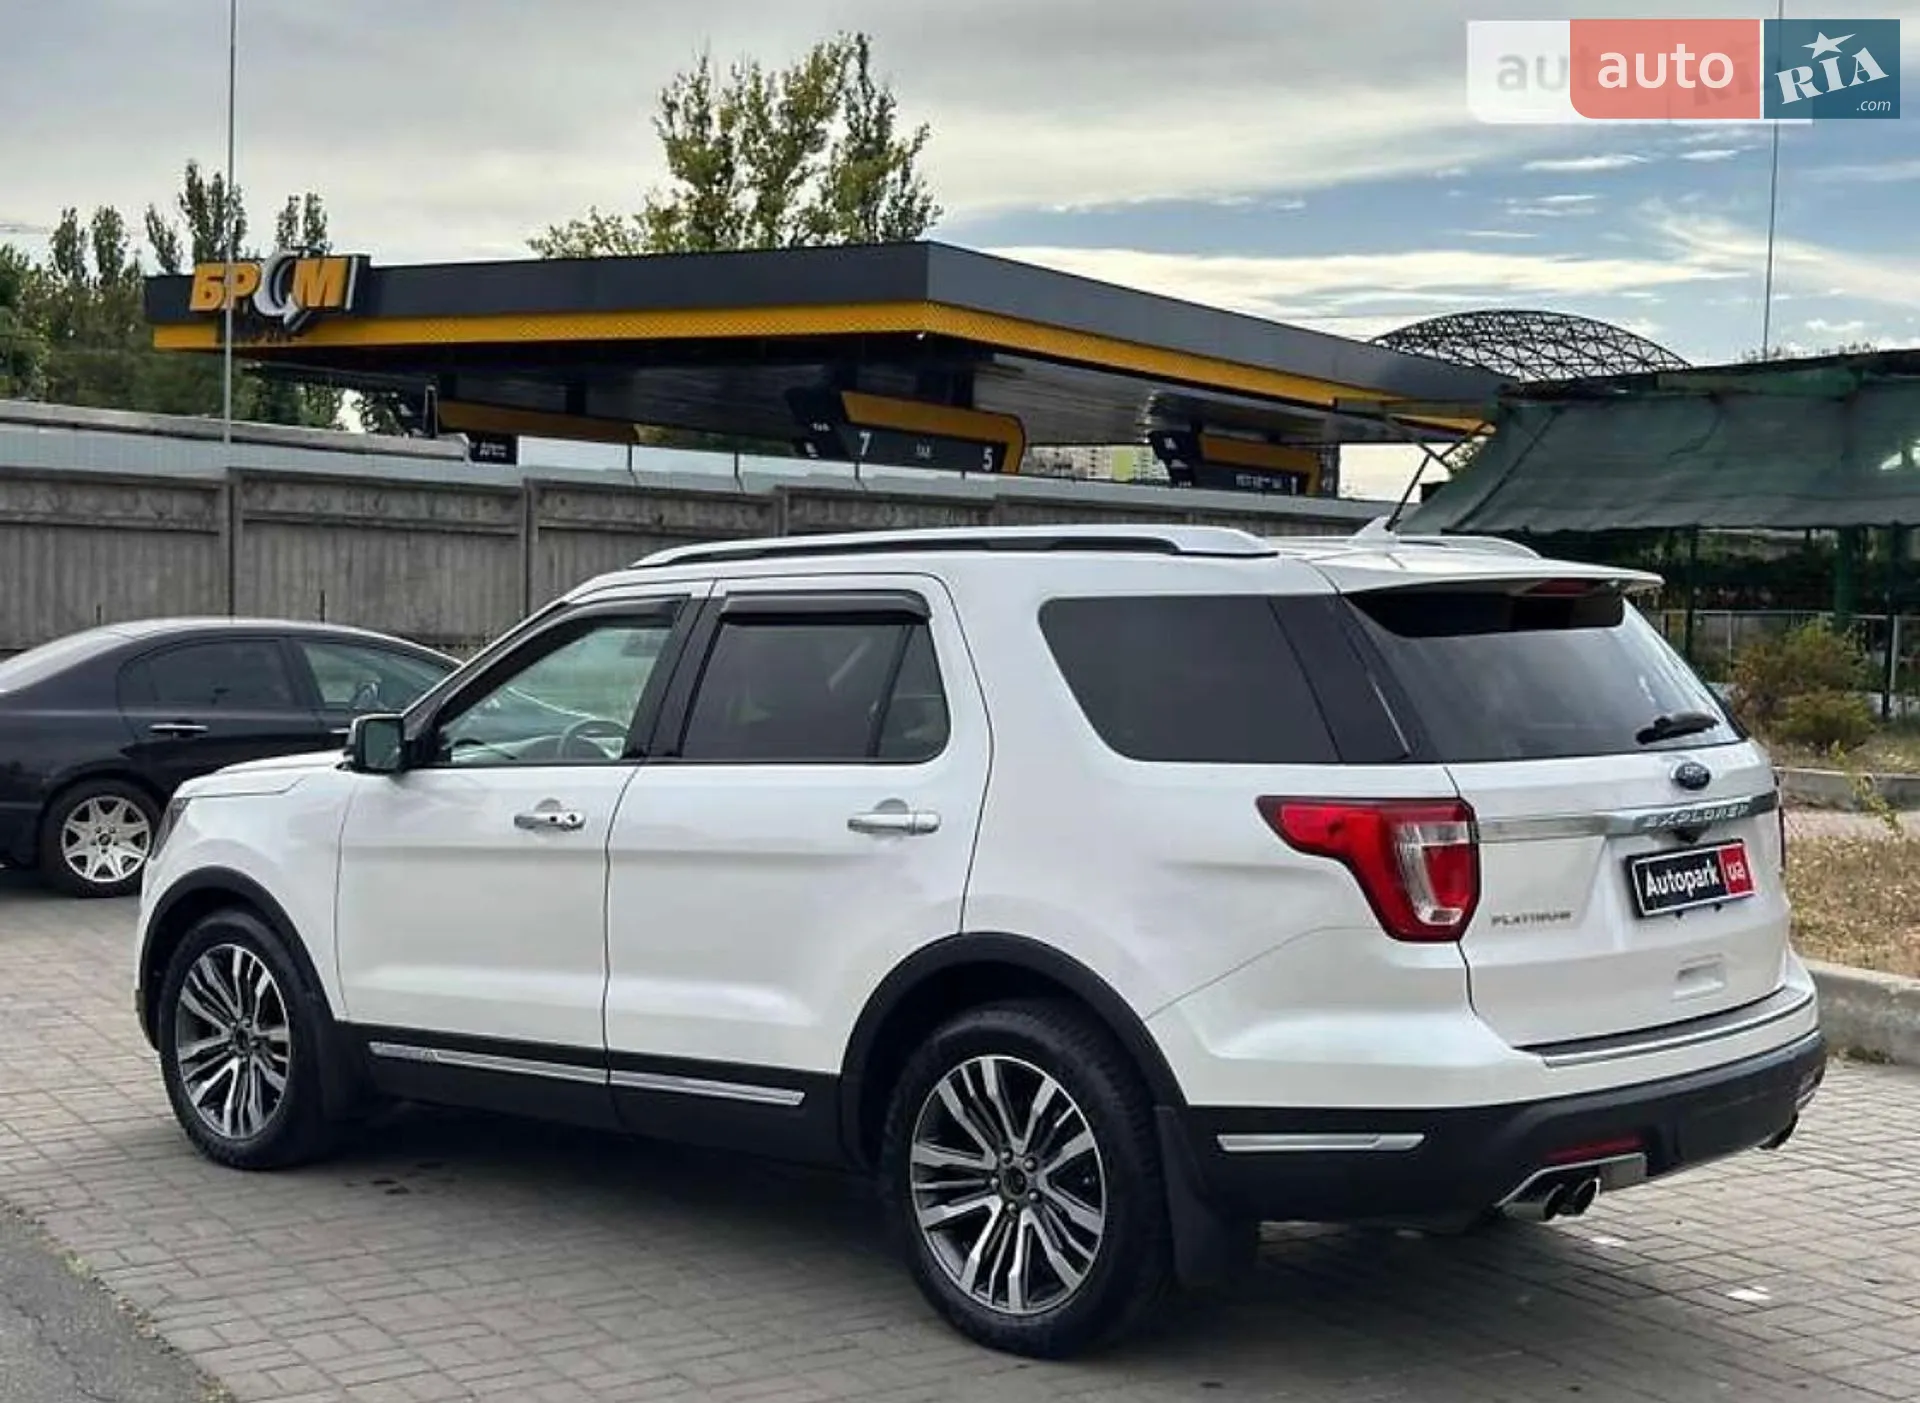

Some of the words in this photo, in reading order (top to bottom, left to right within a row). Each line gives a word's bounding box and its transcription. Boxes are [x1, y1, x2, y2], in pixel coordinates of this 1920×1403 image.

[859, 431, 871, 456] 7
[982, 446, 993, 471] 5
[1646, 859, 1719, 898] Autopark
